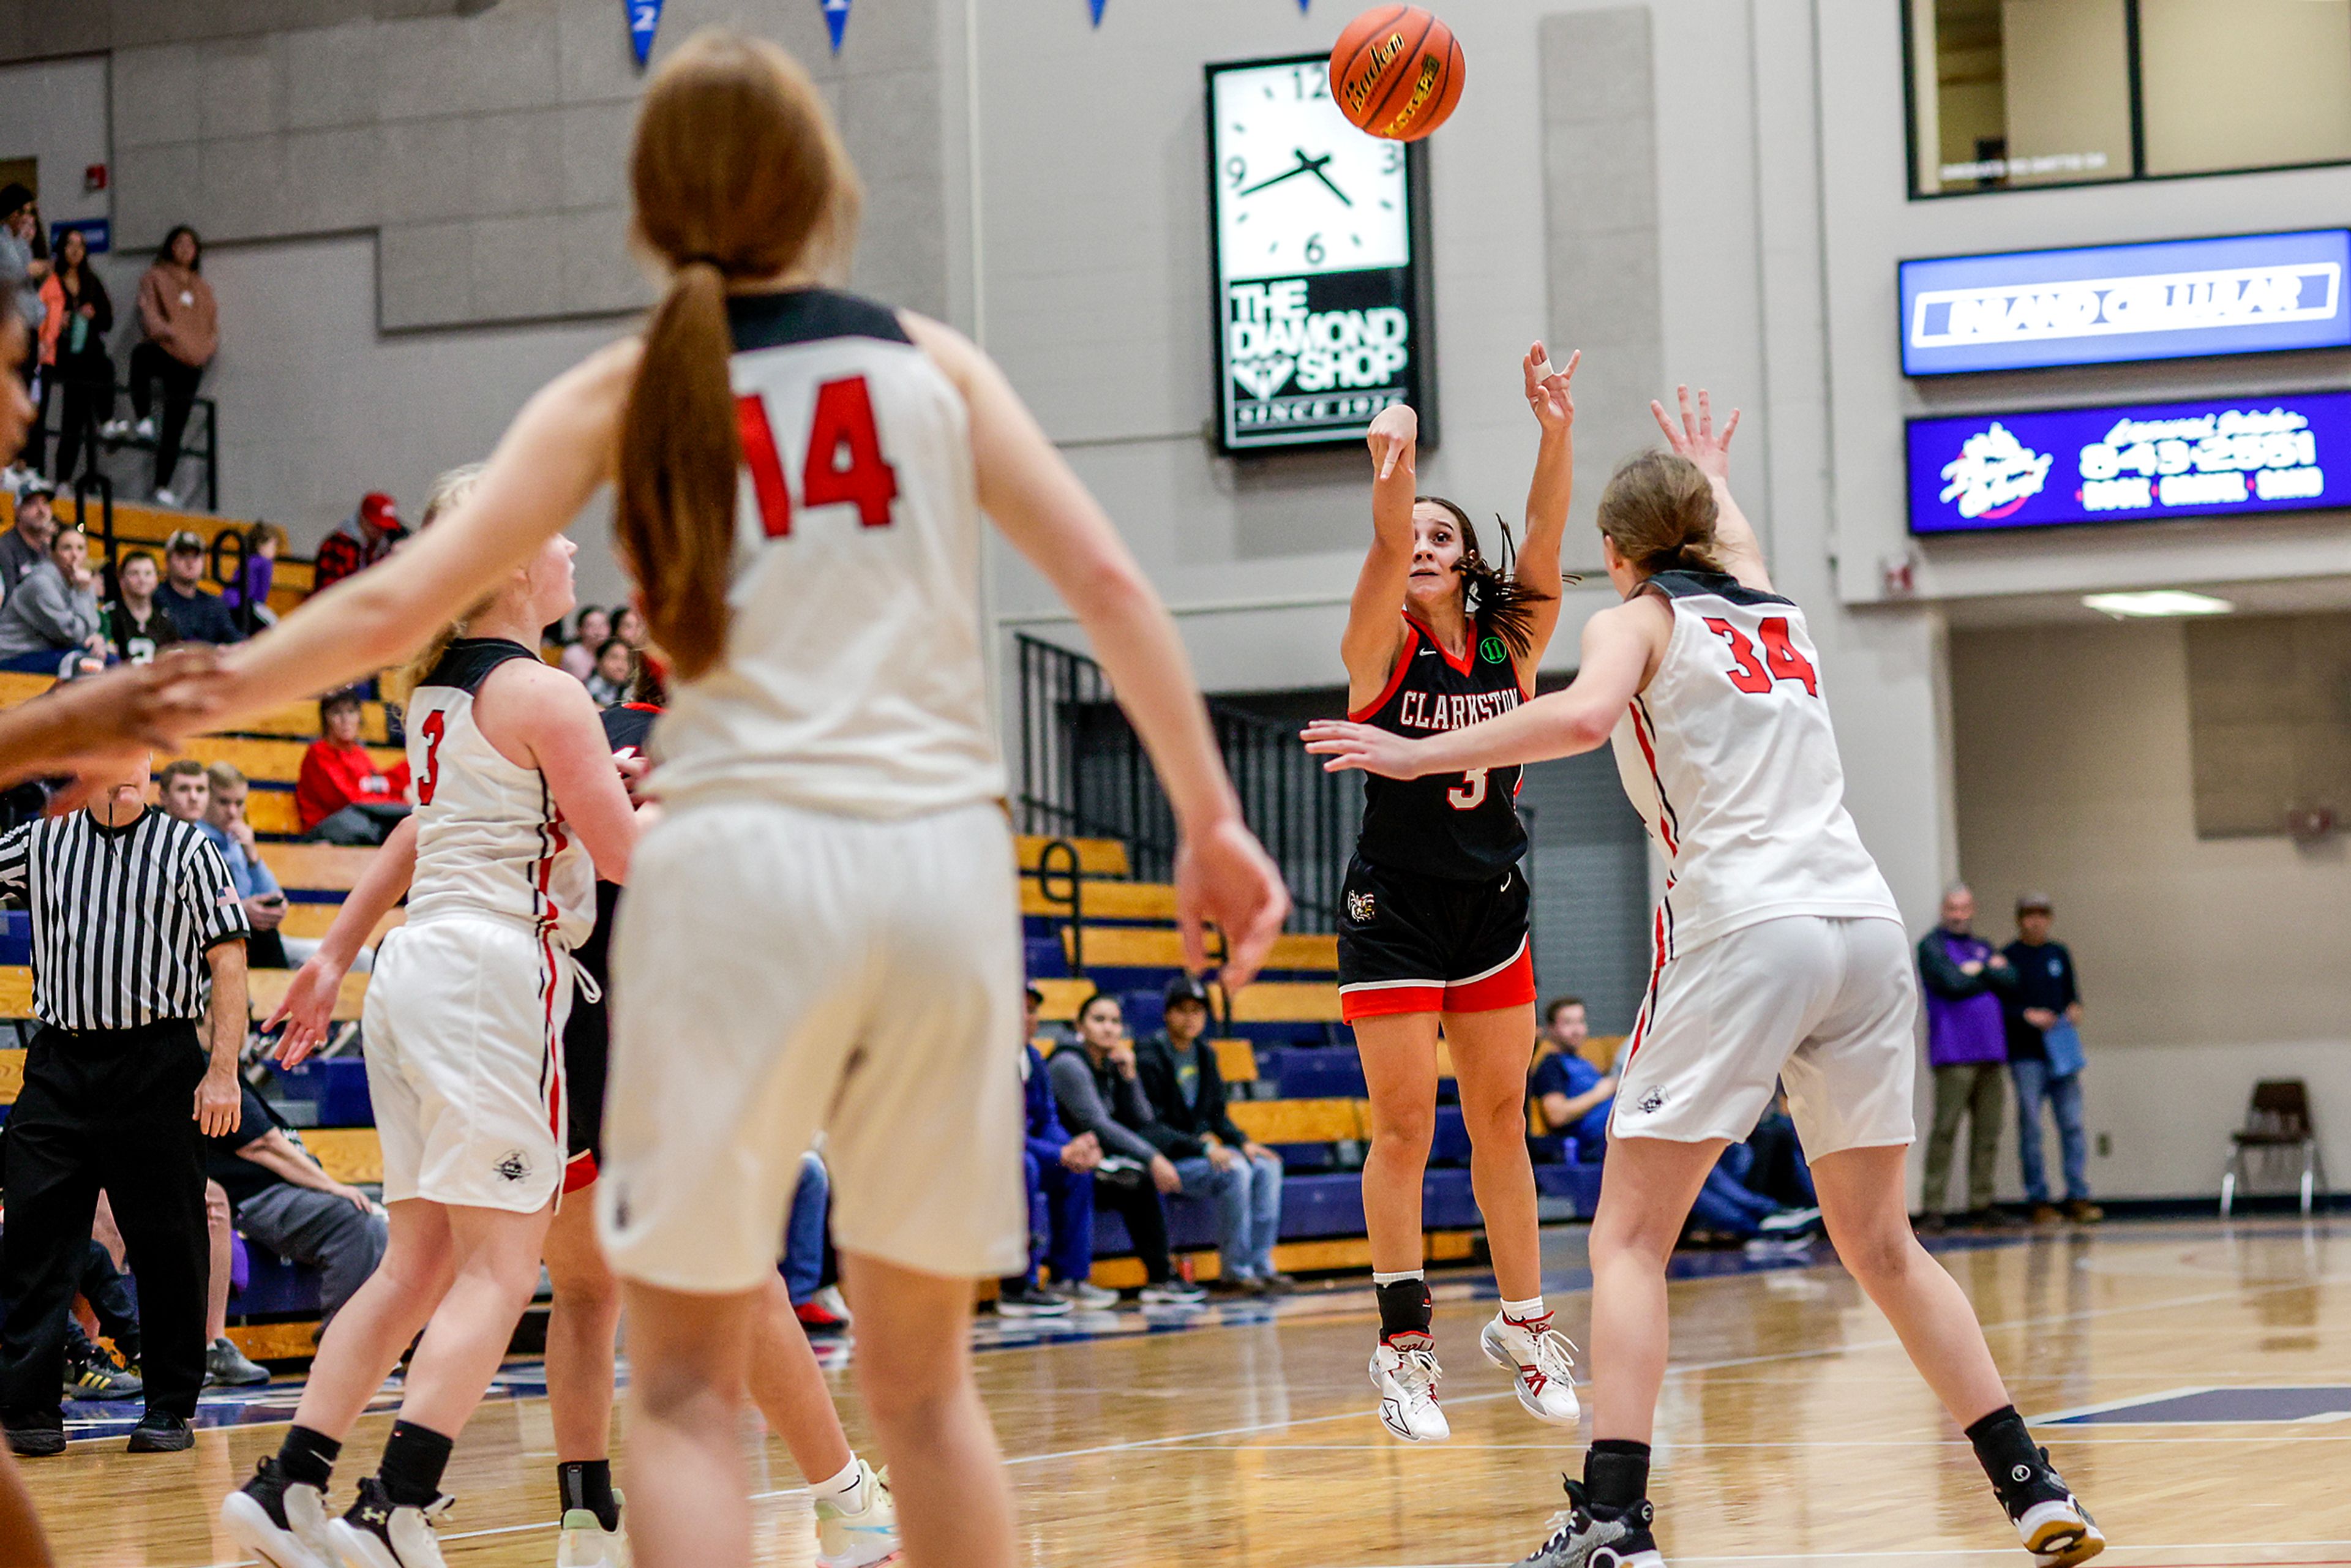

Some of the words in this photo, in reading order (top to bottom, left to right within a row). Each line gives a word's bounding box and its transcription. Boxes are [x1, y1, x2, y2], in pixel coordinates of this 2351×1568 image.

[1291, 62, 1330, 100] 12
[1226, 156, 1246, 189] 9
[1381, 142, 1401, 174] 3
[1304, 231, 1325, 266] 6
[1229, 278, 1309, 322] THE
[1230, 307, 1408, 359] DIAMOND
[1295, 345, 1408, 392] SHOP
[1236, 399, 1327, 427] SINCE
[1484, 639, 1503, 661] 11
[1702, 616, 1818, 699] 34
[1400, 687, 1519, 730] CLARKSTON
[418, 709, 445, 806] 3
[1446, 767, 1491, 811] 3
